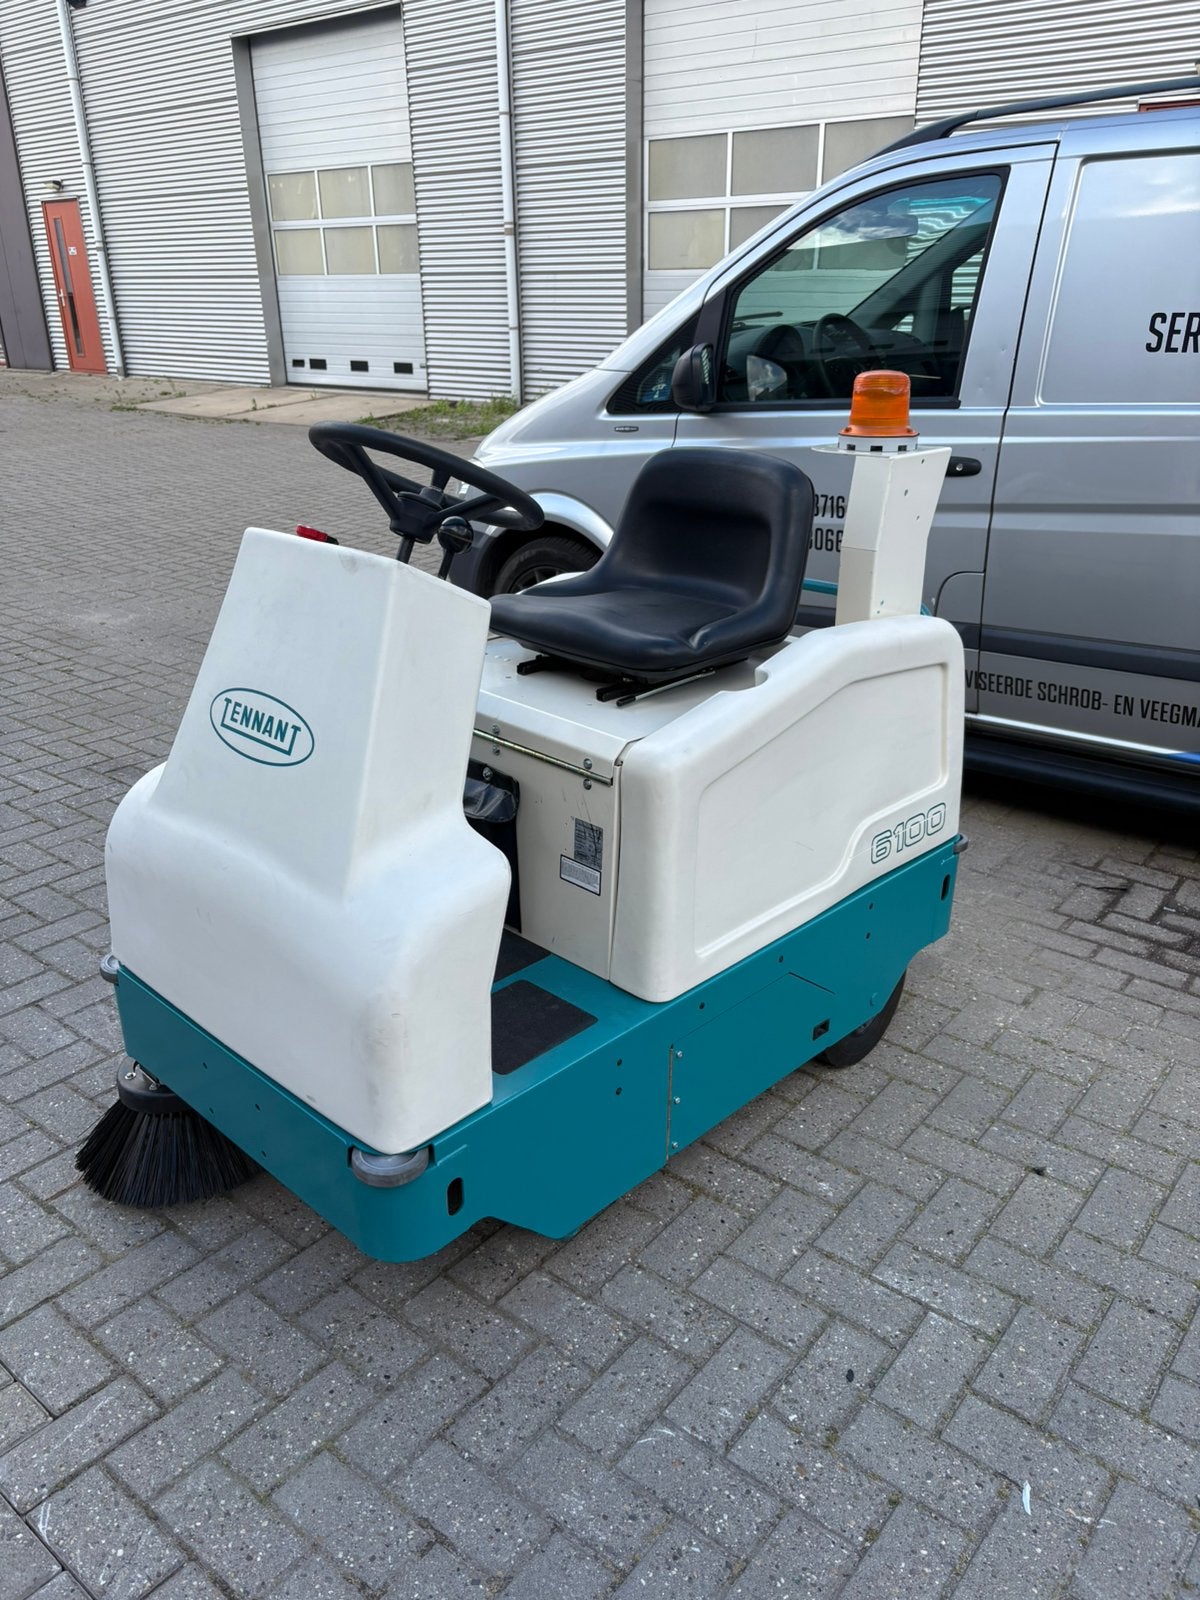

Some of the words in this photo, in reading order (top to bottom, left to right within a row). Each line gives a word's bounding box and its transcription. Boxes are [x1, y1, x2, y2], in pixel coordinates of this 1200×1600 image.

[1145, 312, 1200, 353] SER
[809, 527, 844, 553] 066
[220, 697, 302, 756] TENNANT
[1037, 681, 1109, 708] SCHROB-
[1113, 694, 1134, 716] EN
[1140, 698, 1200, 728] VEEGM
[870, 802, 946, 864] 6100
